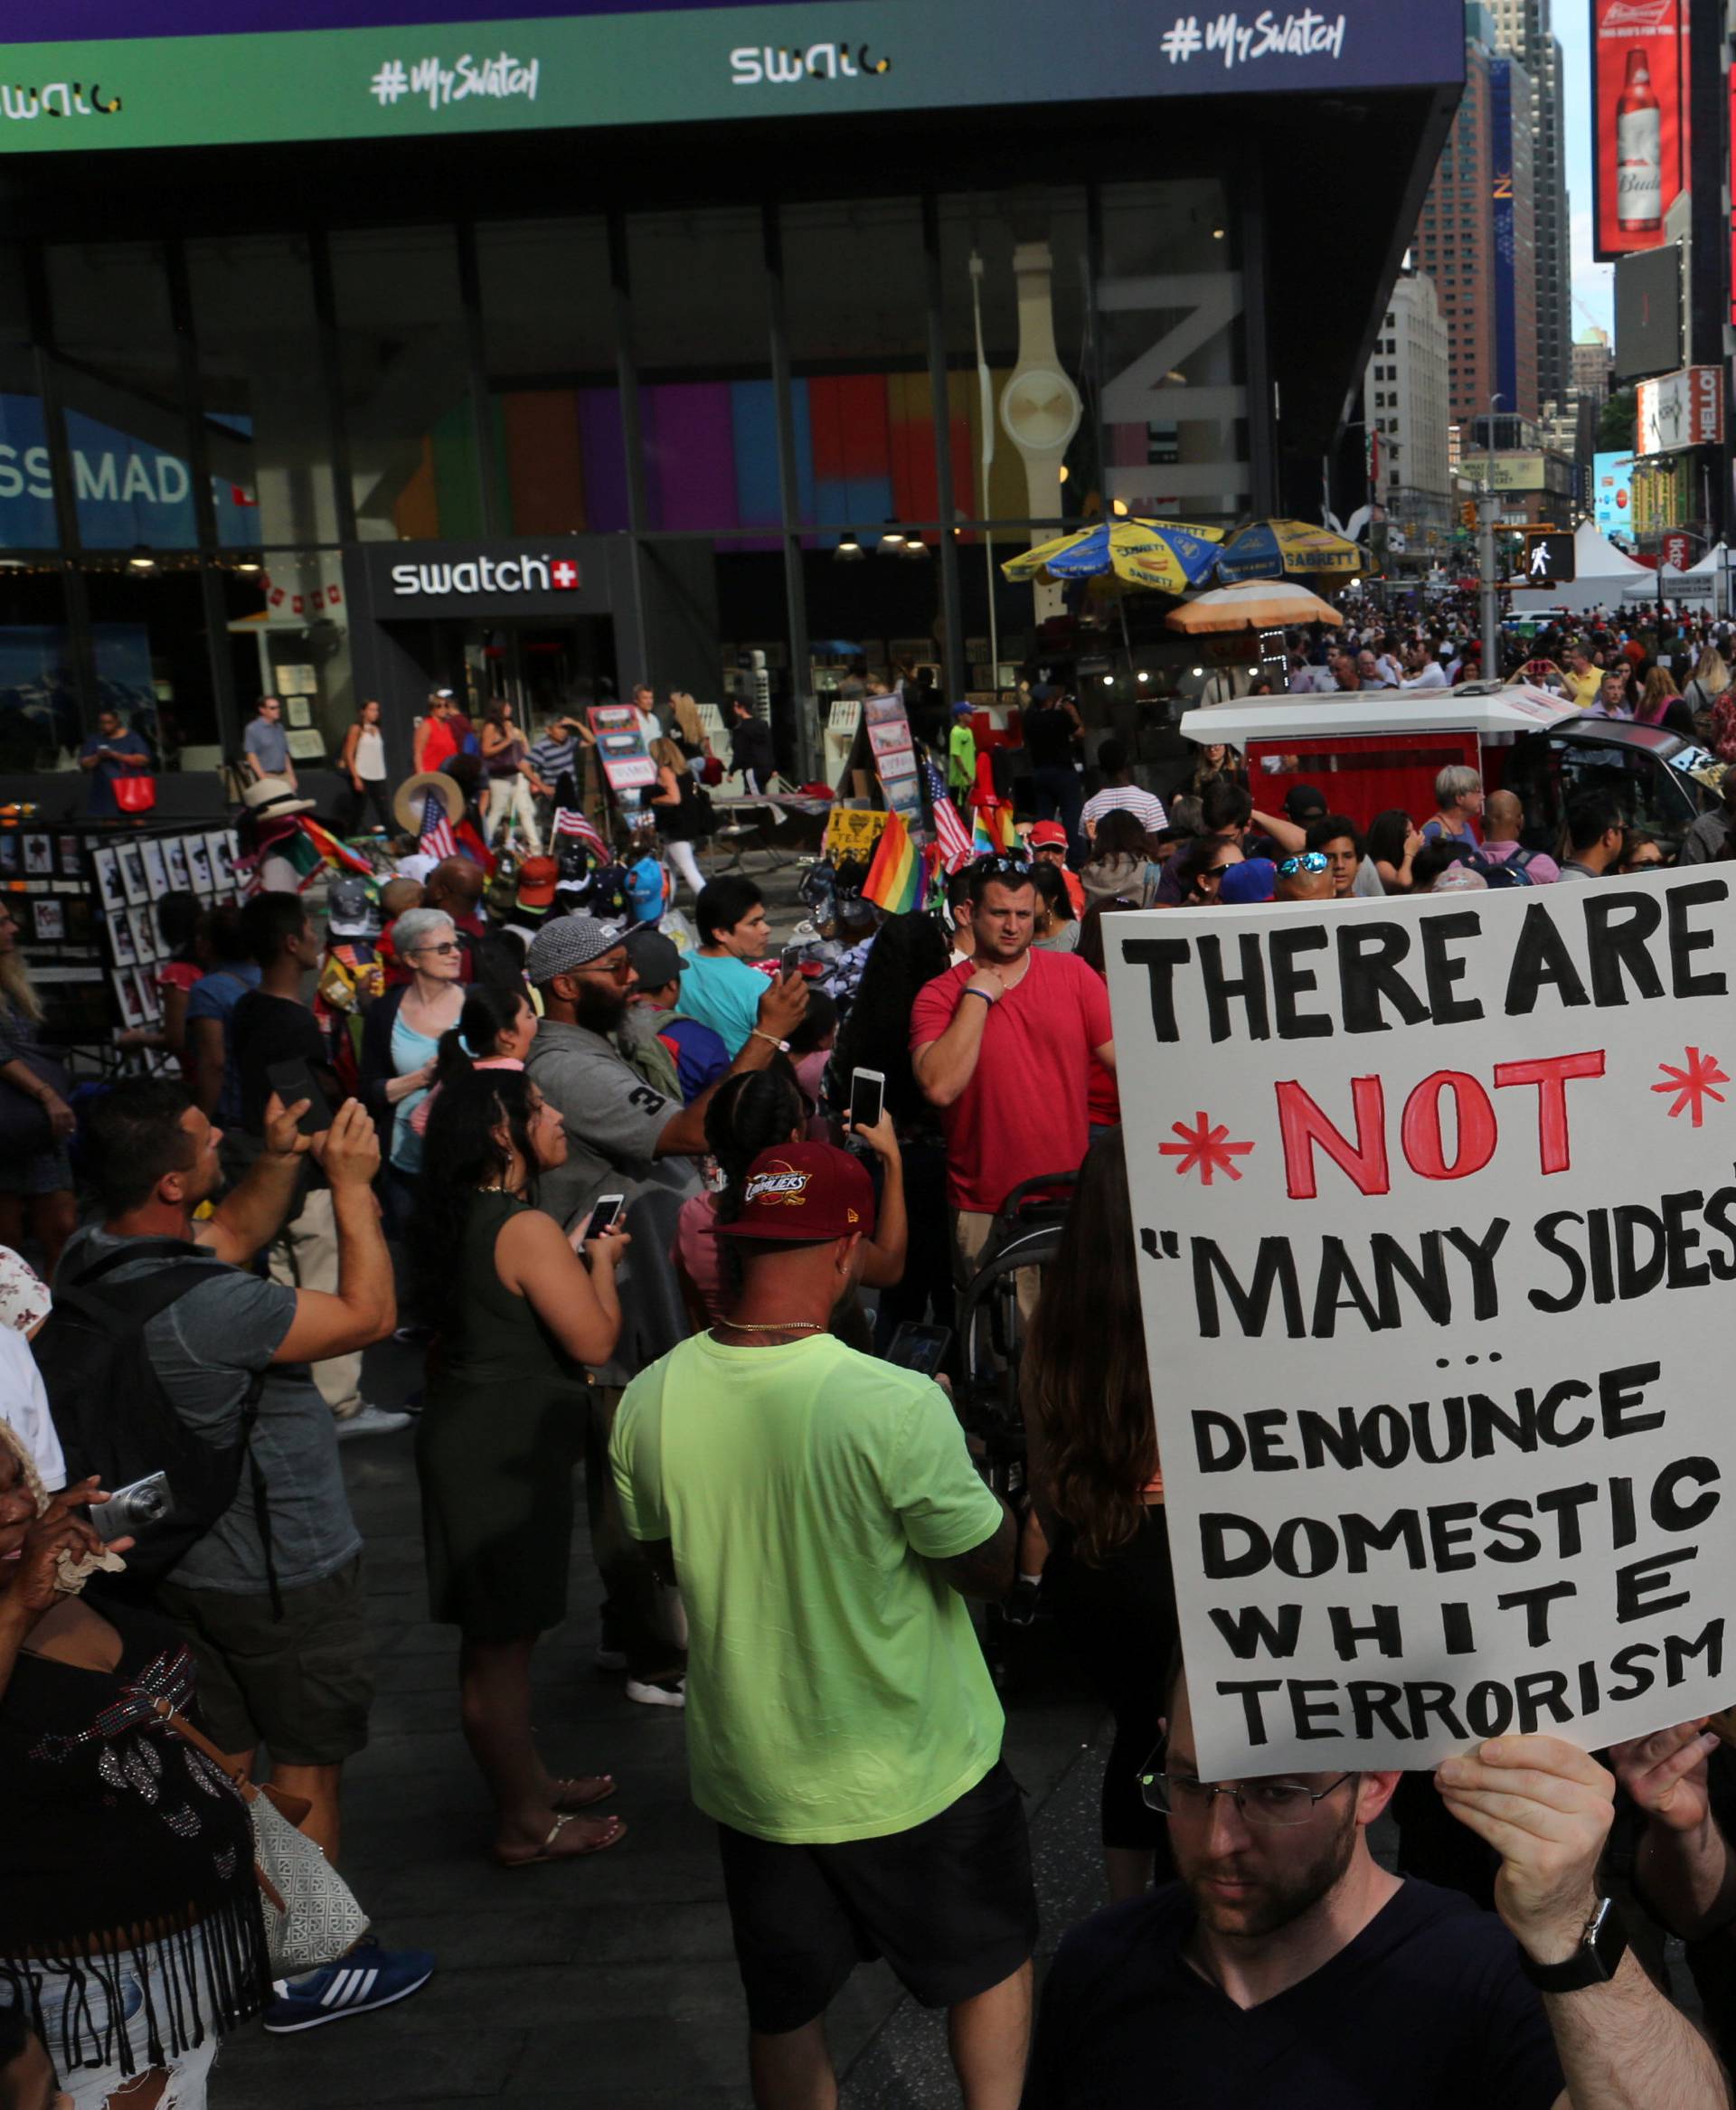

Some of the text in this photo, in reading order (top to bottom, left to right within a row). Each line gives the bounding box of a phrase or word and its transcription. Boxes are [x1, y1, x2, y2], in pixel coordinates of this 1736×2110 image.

[392, 554, 550, 594] swatch
[1287, 552, 1354, 568] SABRETT
[1122, 879, 1729, 1043] THERE ARE
[628, 1087, 666, 1116] 3
[1274, 1049, 1607, 1200] NOT
[1191, 1361, 1666, 1474] DENOUNCE
[1199, 1455, 1722, 1579] DOMESTIC
[1208, 1545, 1698, 1661] WHITE
[1216, 1617, 1725, 1747] TERRORISM
